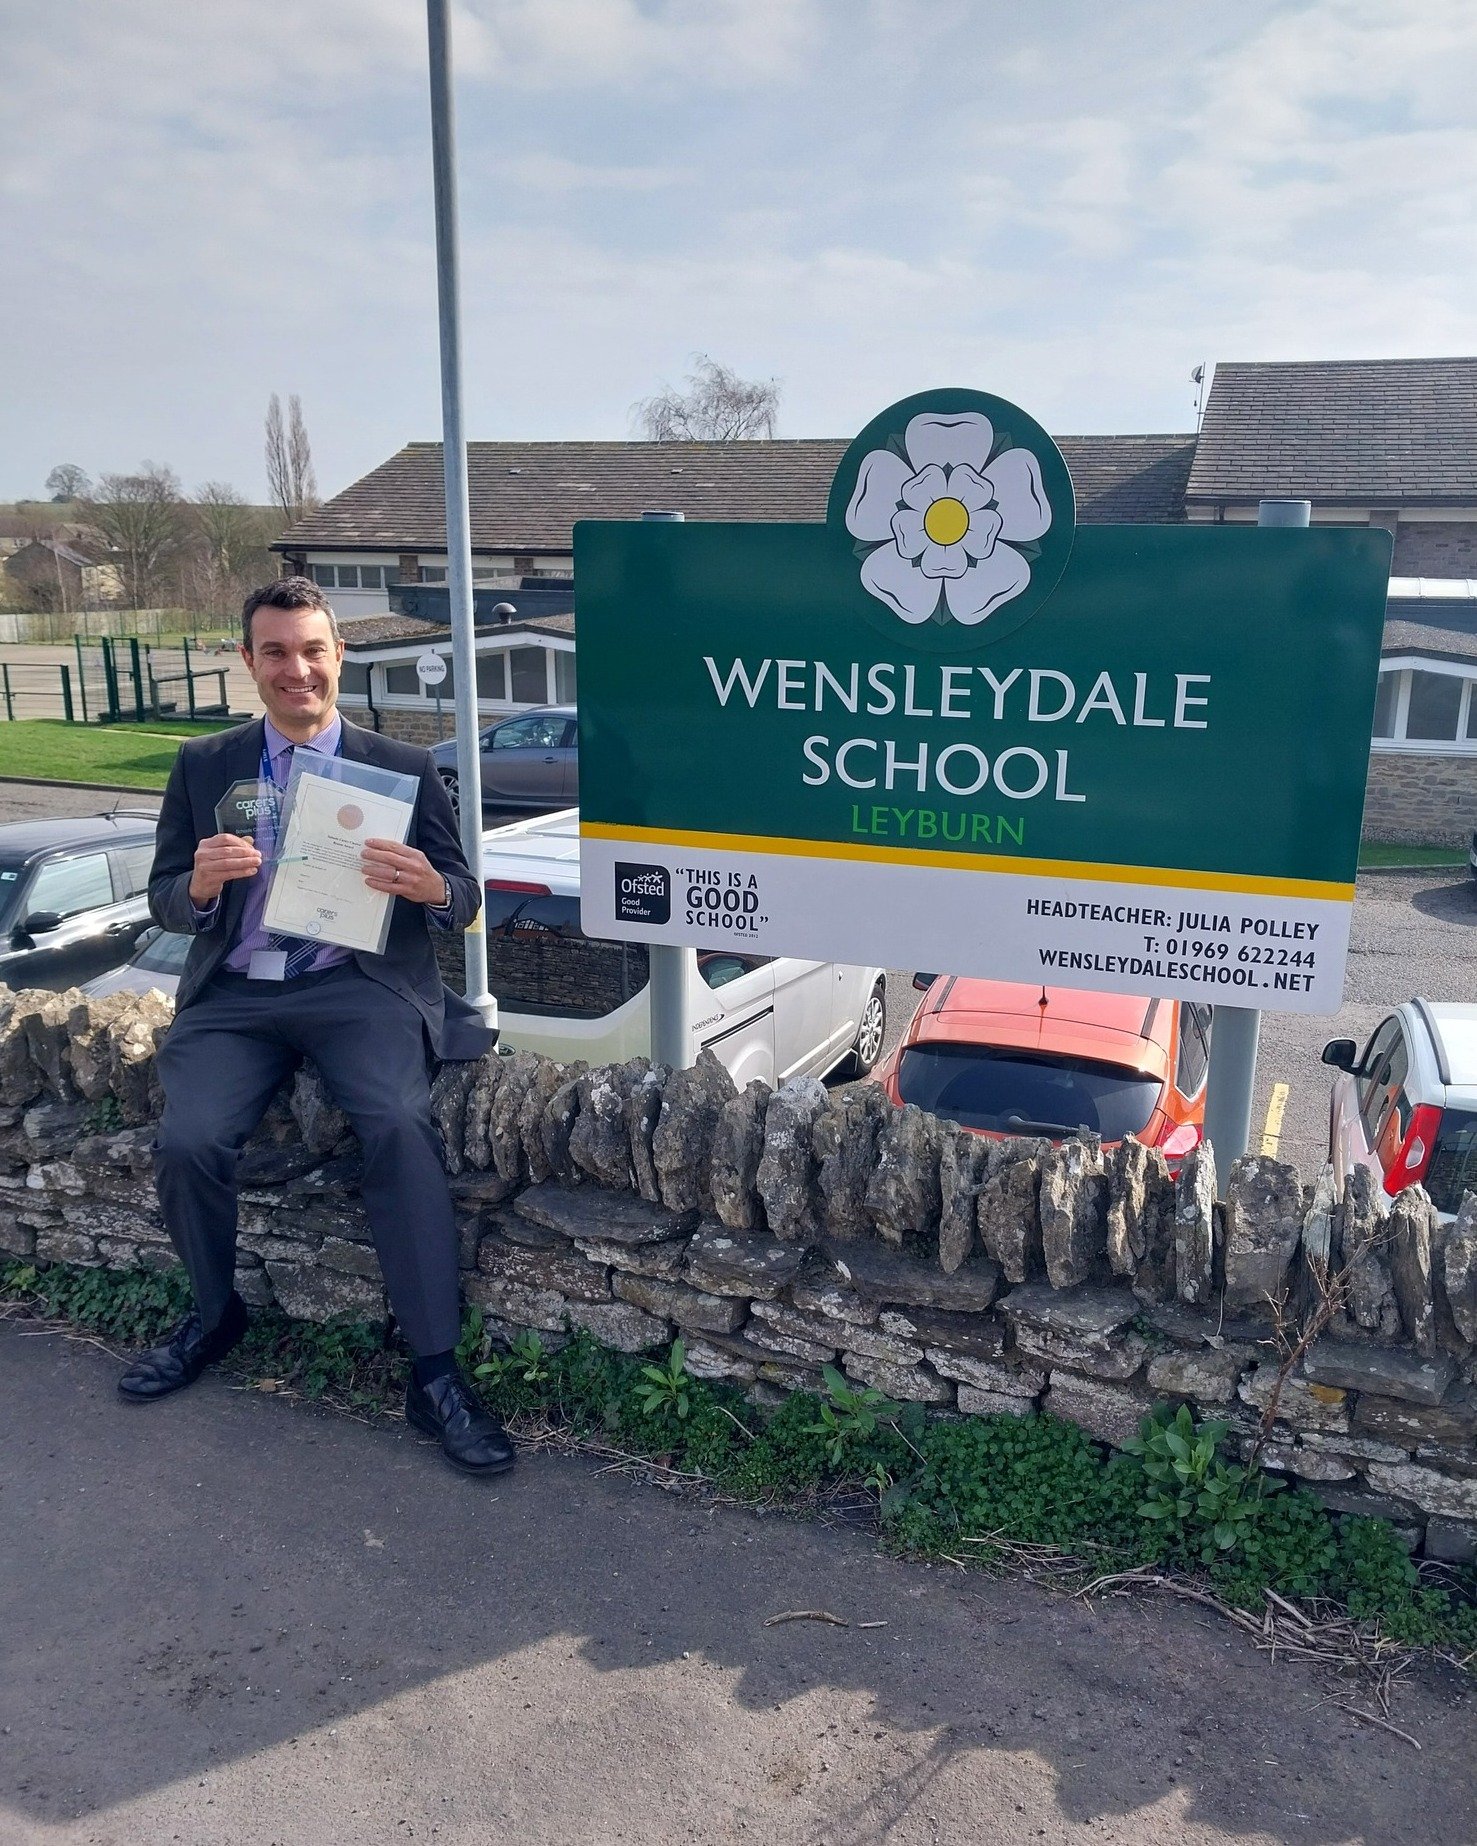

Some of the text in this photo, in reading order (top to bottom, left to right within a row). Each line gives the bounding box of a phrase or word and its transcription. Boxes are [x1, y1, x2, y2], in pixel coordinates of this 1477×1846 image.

[702, 656, 1212, 730] WENSLEYDALE
[802, 734, 1087, 803] SCHOOL
[235, 797, 276, 810] carers
[245, 806, 272, 820] plus
[850, 804, 1026, 847] LEYBURN
[621, 878, 665, 897] Ofsted
[728, 872, 742, 888] IS
[747, 874, 758, 889] A
[621, 897, 641, 907] Good
[686, 885, 759, 914] GOOD
[316, 907, 338, 917] carers
[319, 912, 334, 920] plus
[621, 906, 651, 917] Provider
[1026, 898, 1320, 941] HEADTEACHER: JULIA POLLEY
[1143, 936, 1316, 969] T: 01969 622244
